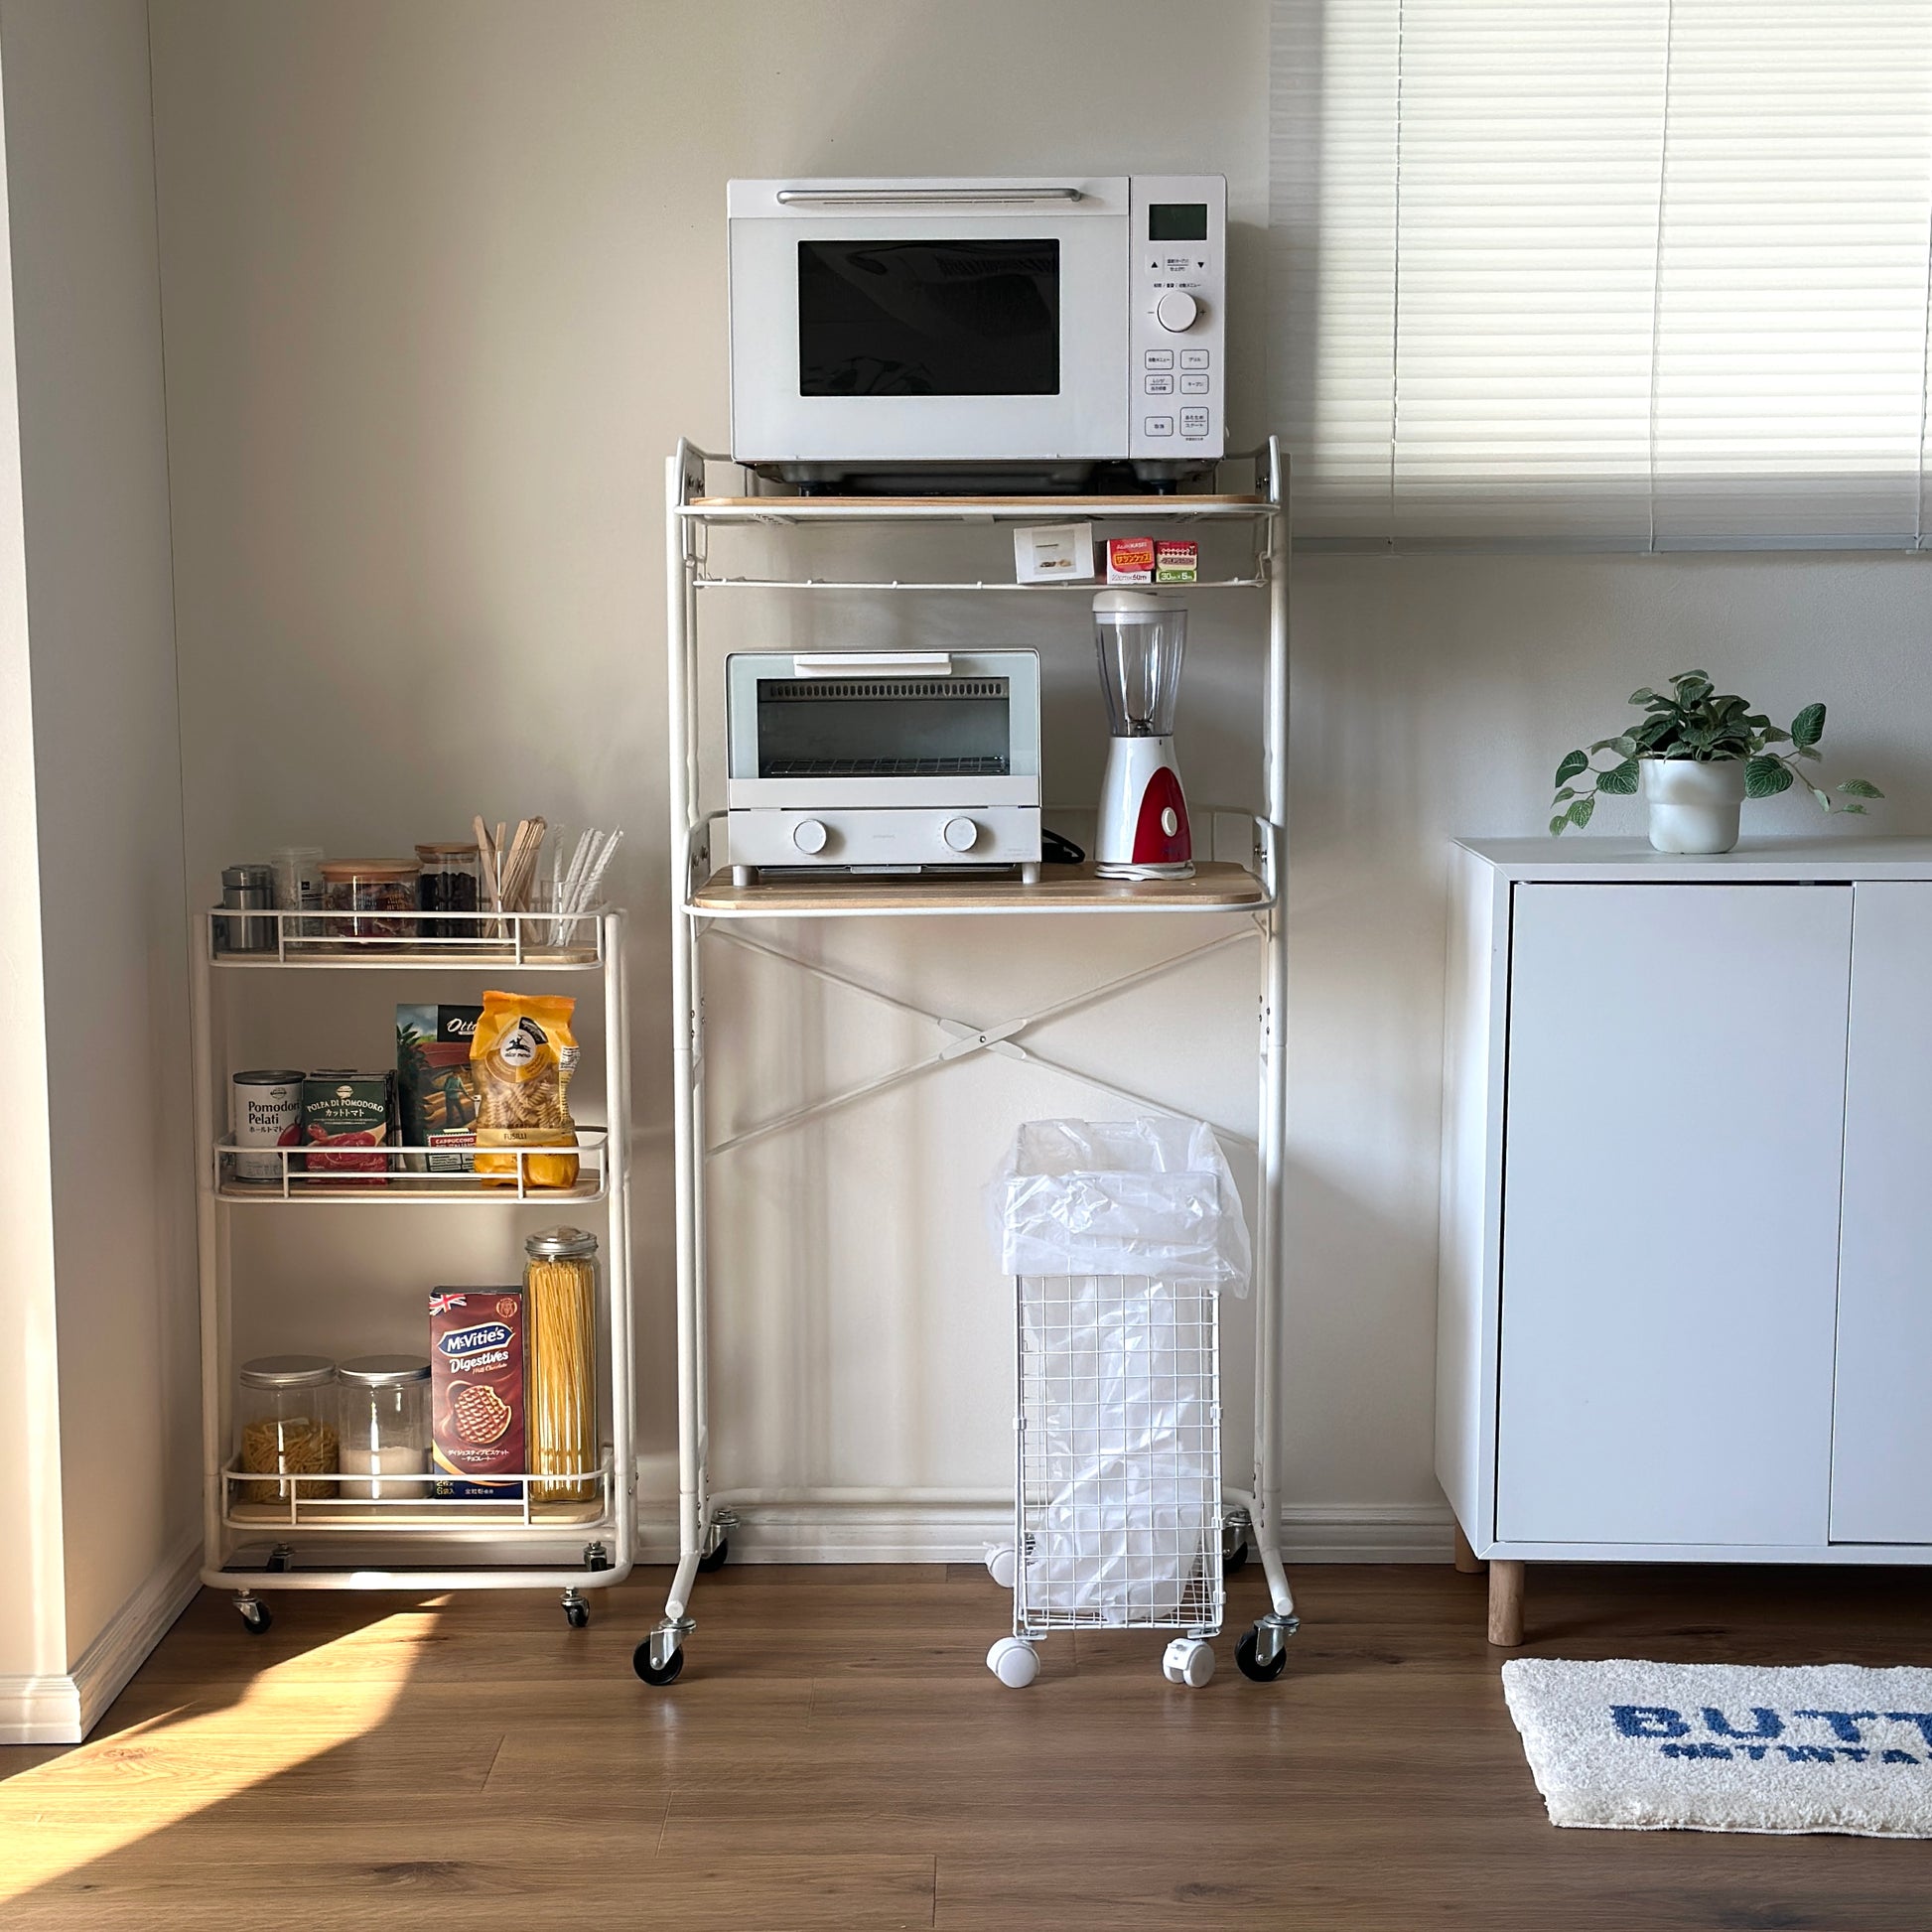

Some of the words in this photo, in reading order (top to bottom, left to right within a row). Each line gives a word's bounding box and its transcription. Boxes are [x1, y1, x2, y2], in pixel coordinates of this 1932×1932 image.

[307, 1101, 330, 1112] POLPA
[341, 1099, 384, 1113] POMODORO
[326, 1108, 364, 1118] カットトマト
[248, 1113, 279, 1125] Pelati
[447, 1326, 505, 1352] McVitie's
[449, 1350, 509, 1374] Digestives
